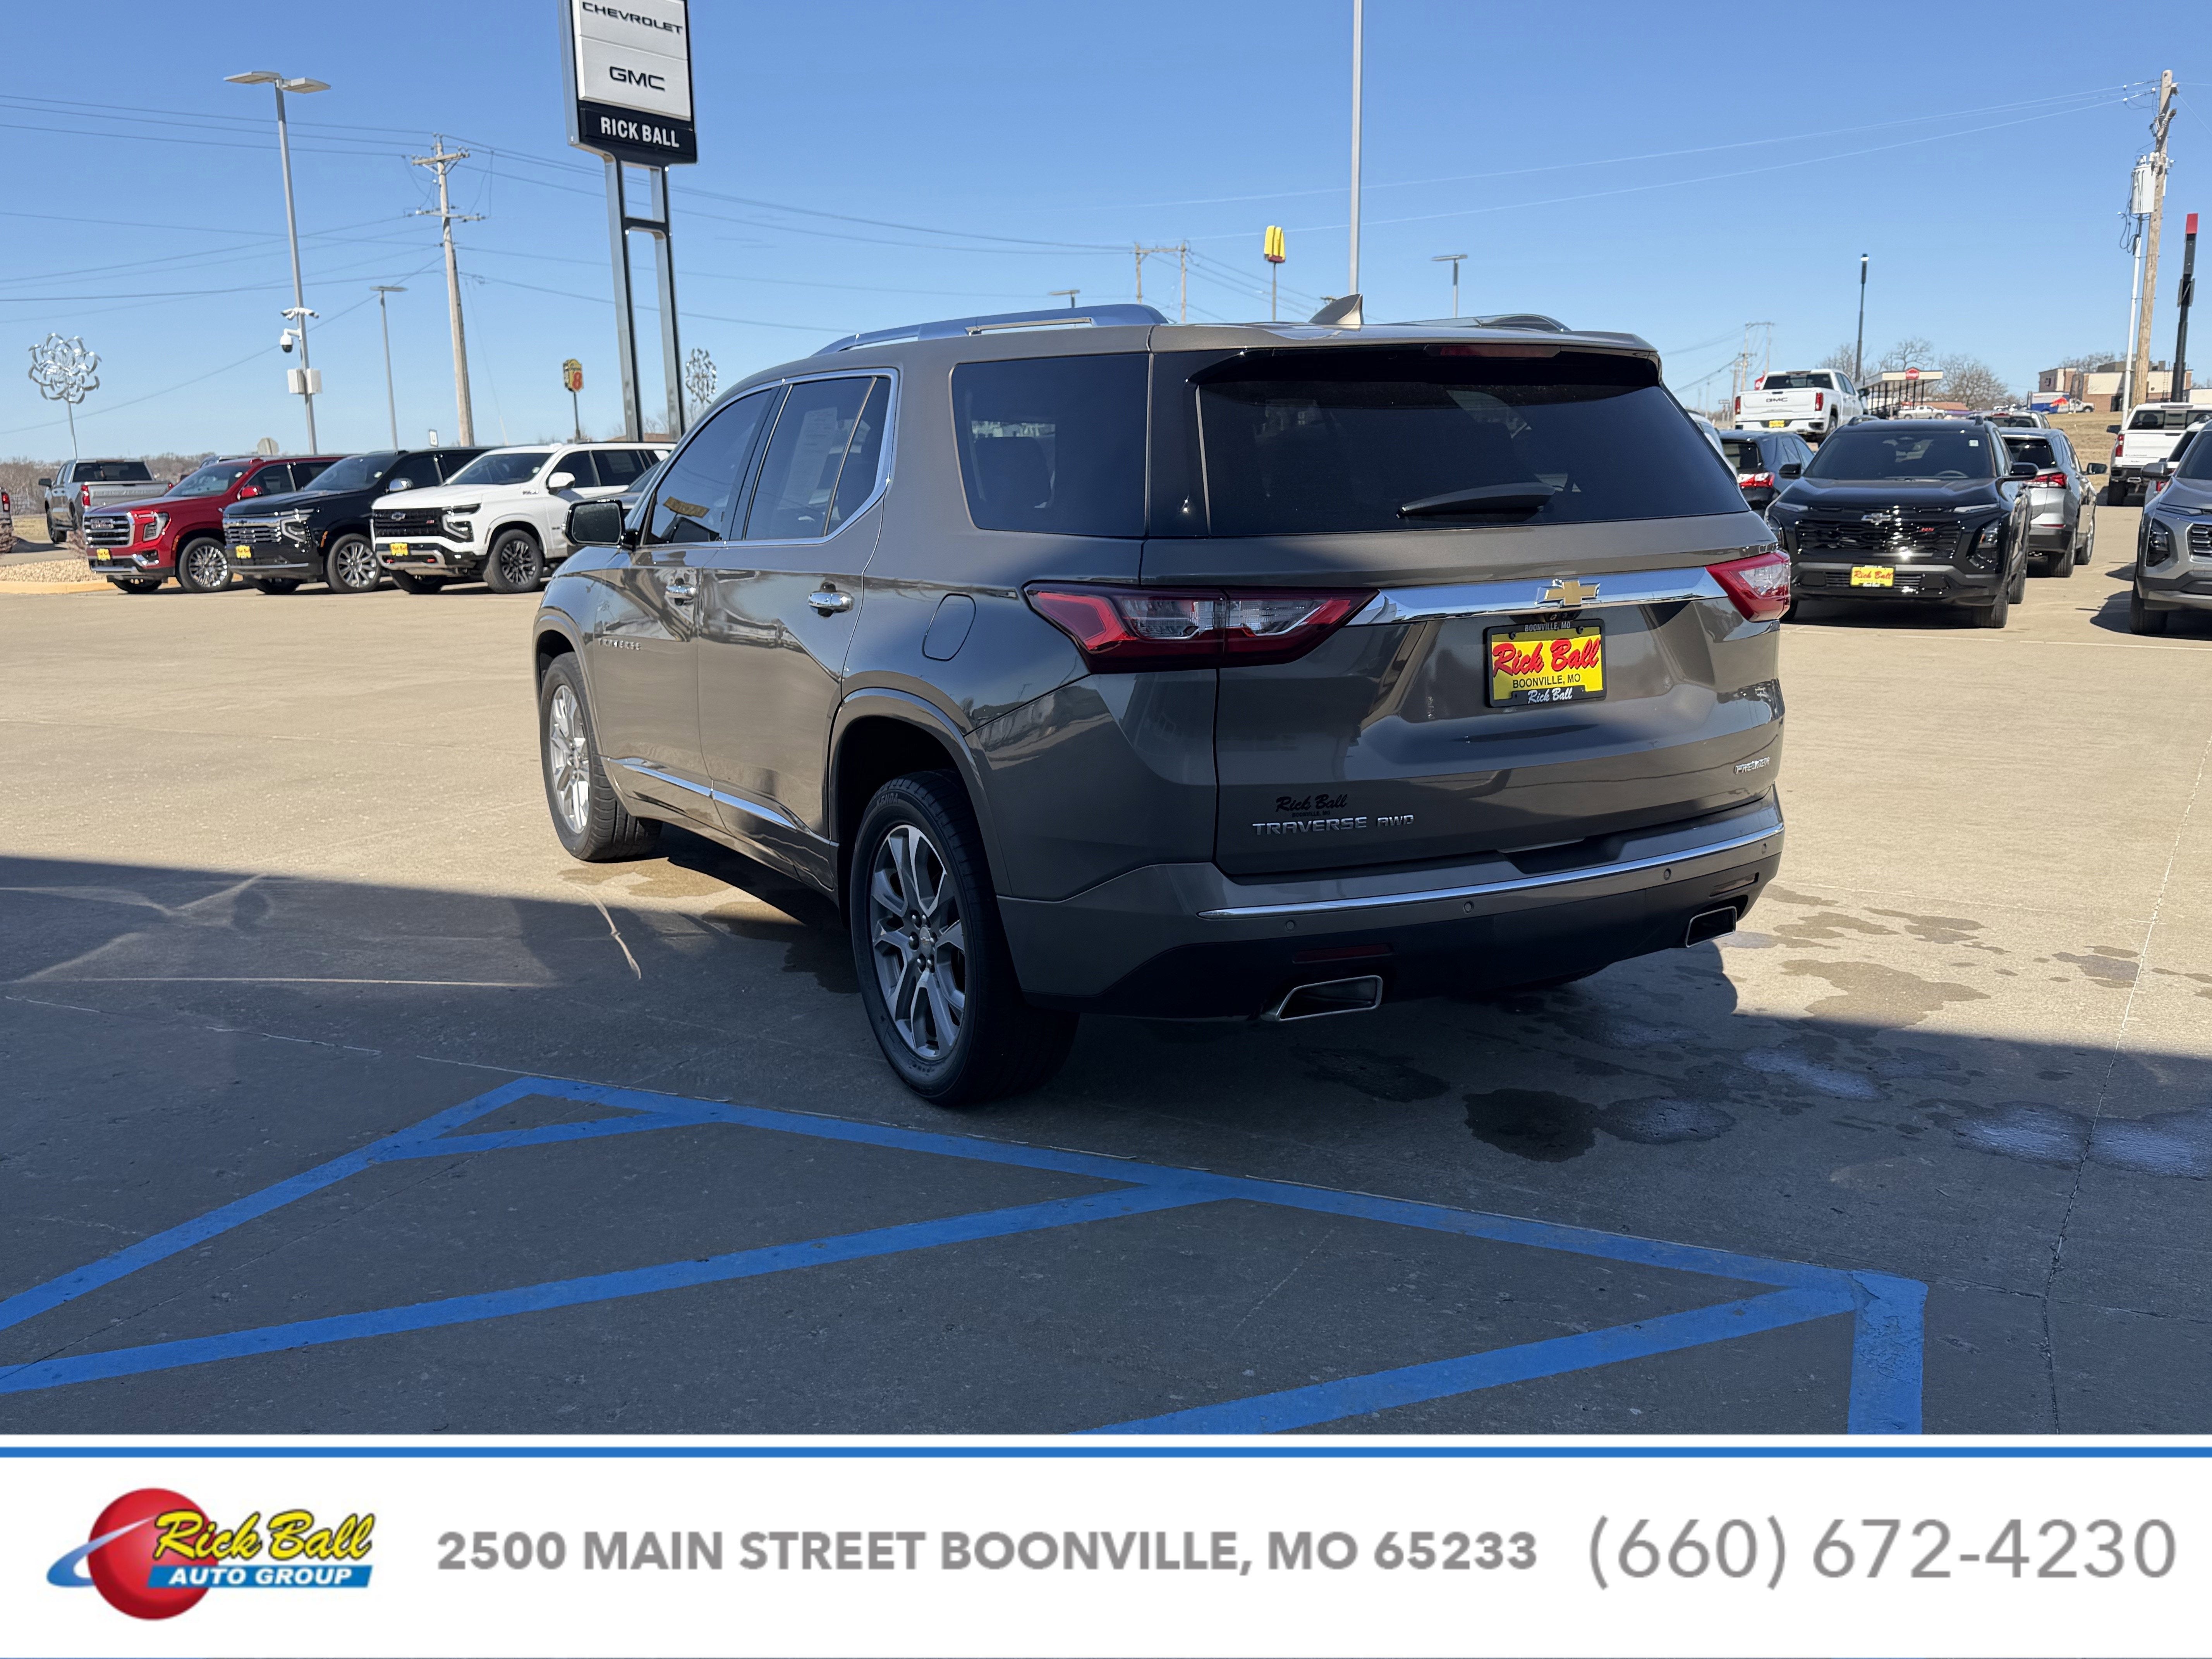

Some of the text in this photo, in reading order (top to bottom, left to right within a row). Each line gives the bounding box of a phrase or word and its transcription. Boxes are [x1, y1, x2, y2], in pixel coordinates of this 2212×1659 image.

[582, 2, 682, 34] CHEVROLET
[609, 66, 665, 91] GMC
[600, 117, 680, 148] RICK BALL
[1853, 570, 1893, 579] Rick Ball
[1525, 622, 1559, 632] BOONVILLE,
[1492, 638, 1601, 677] Rick Ball
[1513, 673, 1580, 689] BOONVILLE, MO
[1528, 687, 1573, 704] Rick Ball
[1276, 794, 1348, 812] Rick Ball
[1252, 815, 1414, 835] TRAVERSE AWD
